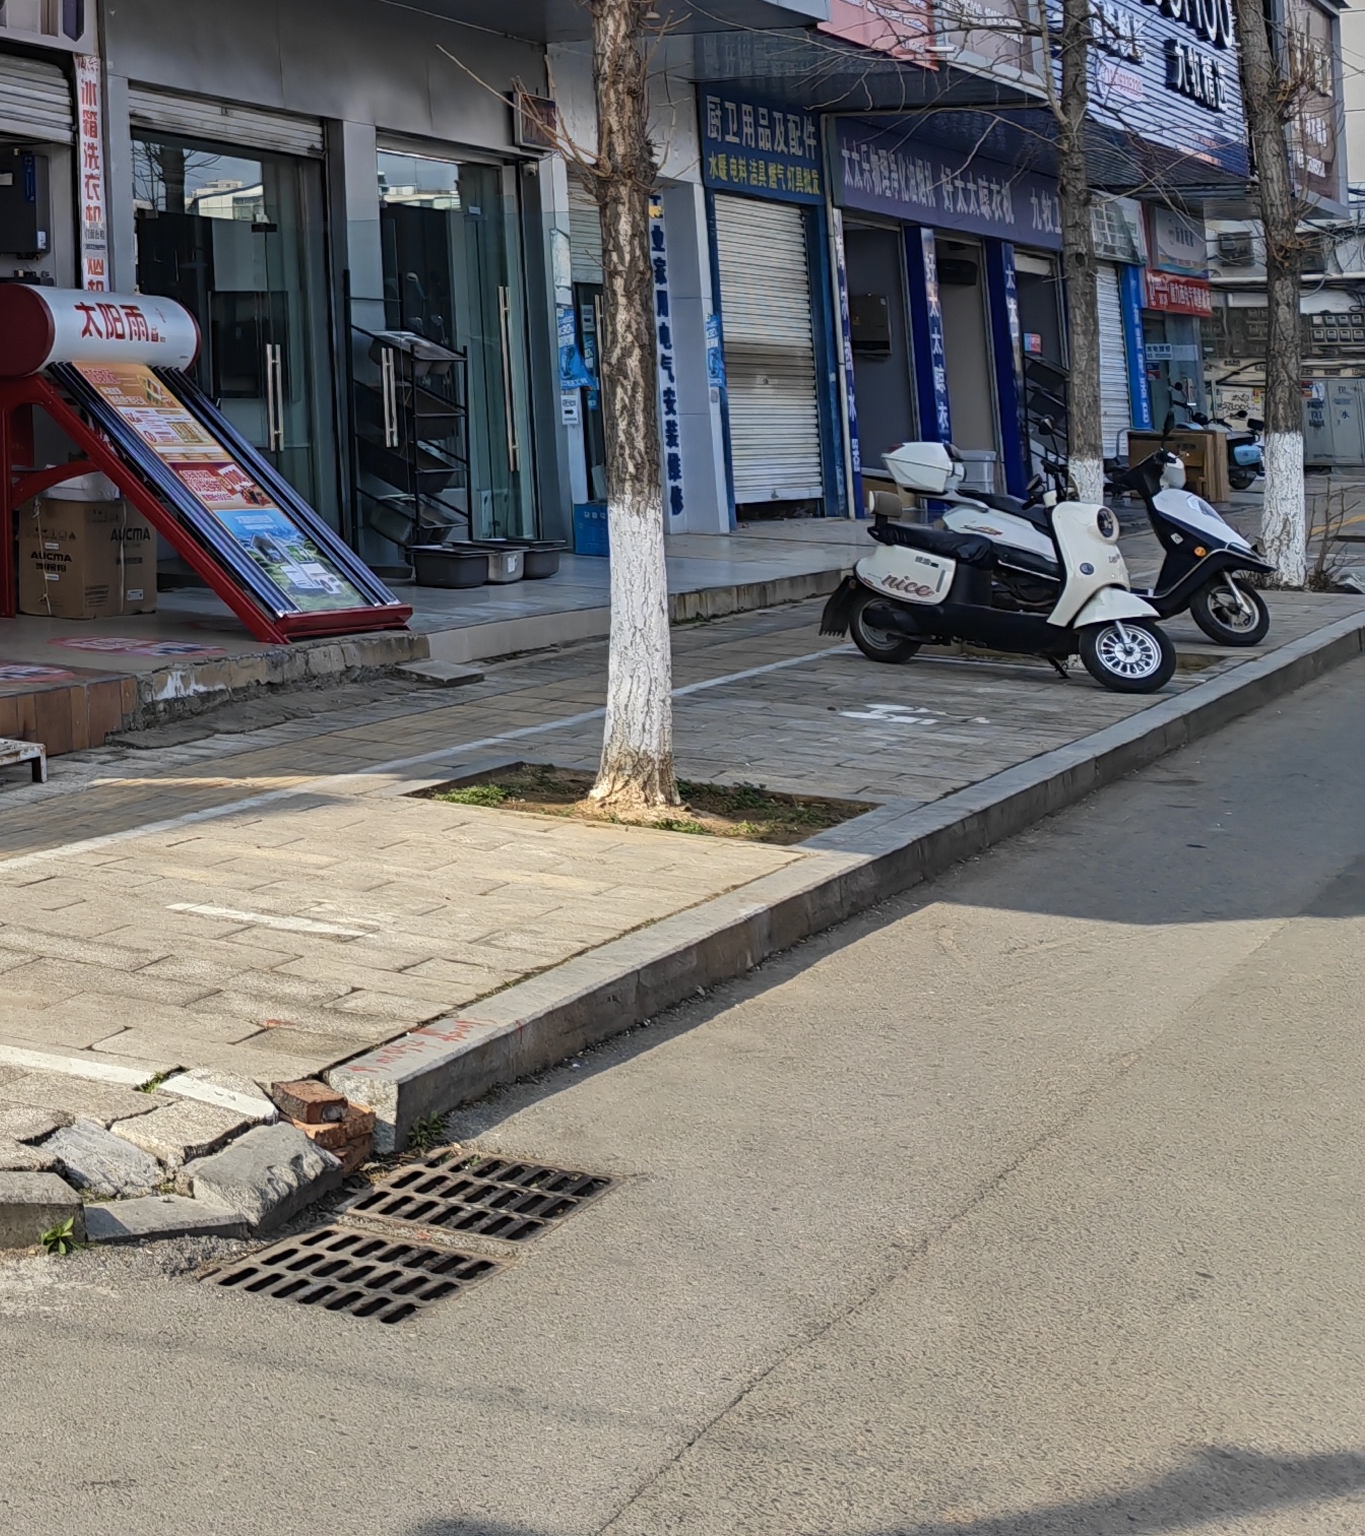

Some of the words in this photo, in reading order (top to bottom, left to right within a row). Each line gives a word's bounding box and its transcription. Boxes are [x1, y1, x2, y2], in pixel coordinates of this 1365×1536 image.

[706, 95, 817, 160] 厨卫用品及配件
[74, 301, 149, 342] 太阳雨
[924, 252, 950, 447] 好太太晾衣
[110, 527, 151, 541] AUCMA
[30, 551, 73, 562] AUCMA
